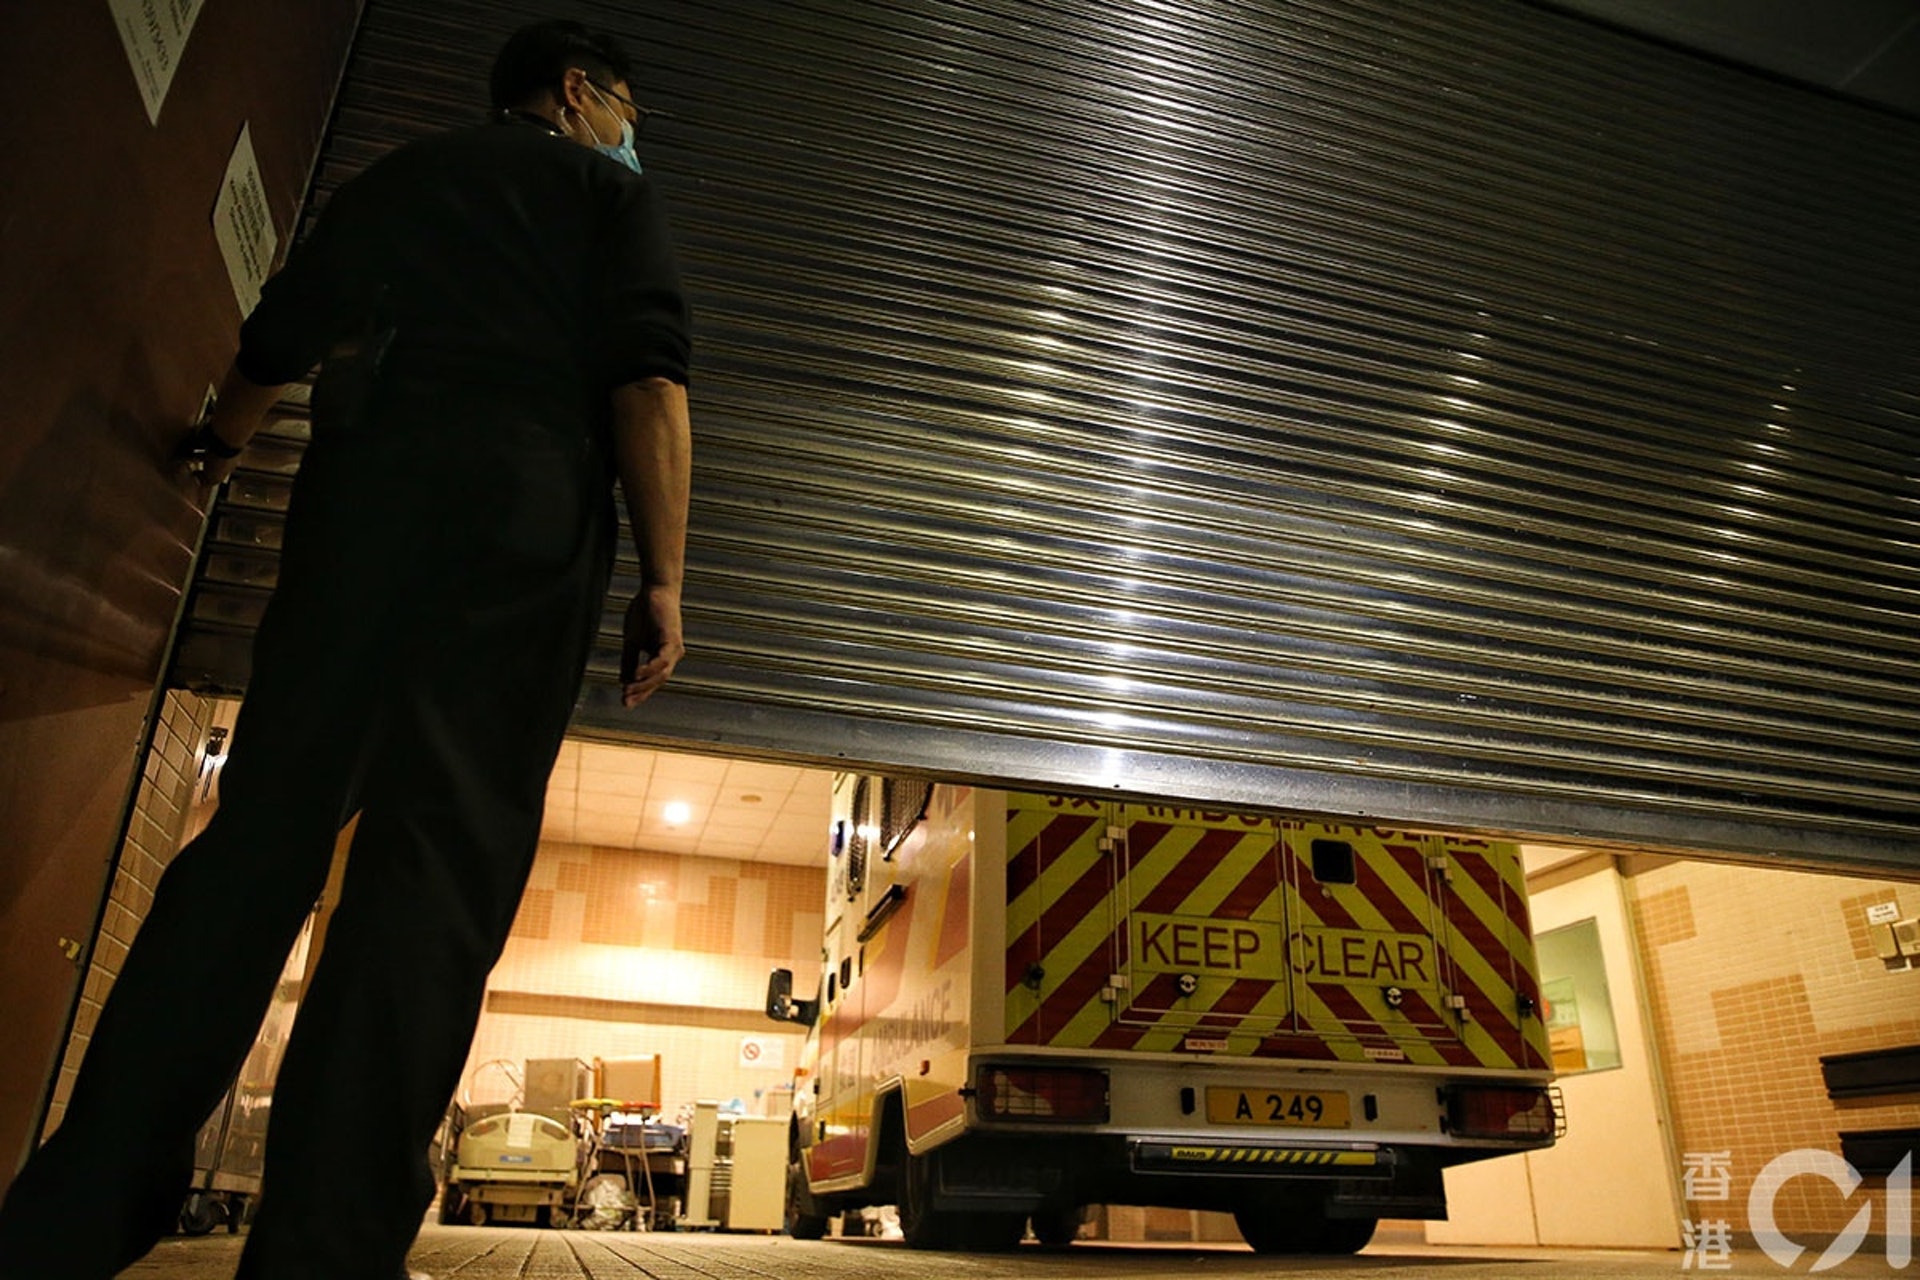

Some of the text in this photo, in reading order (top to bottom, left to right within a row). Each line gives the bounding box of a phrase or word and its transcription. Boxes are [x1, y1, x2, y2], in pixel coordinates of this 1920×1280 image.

[1141, 921, 1429, 982] KEEP CLEAR
[1235, 1093, 1324, 1121] A 249
